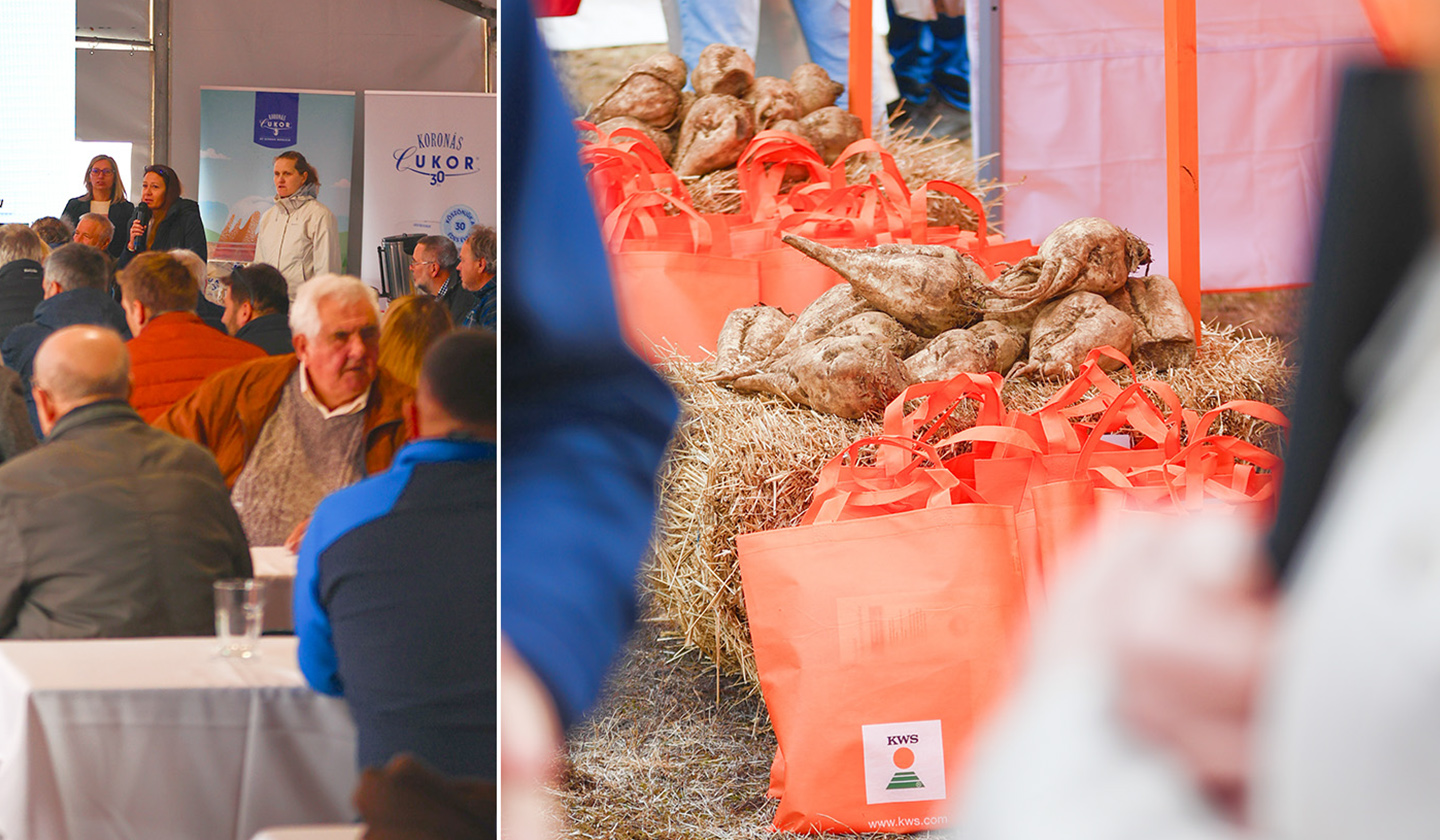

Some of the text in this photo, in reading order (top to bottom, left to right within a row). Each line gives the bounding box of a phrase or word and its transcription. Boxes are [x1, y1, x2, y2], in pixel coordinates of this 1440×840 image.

[417, 131, 464, 151] KORONÁS
[430, 170, 446, 186] 30
[455, 221, 466, 231] 30
[886, 734, 919, 746] KWS
[867, 816, 948, 829] www.kws.com
